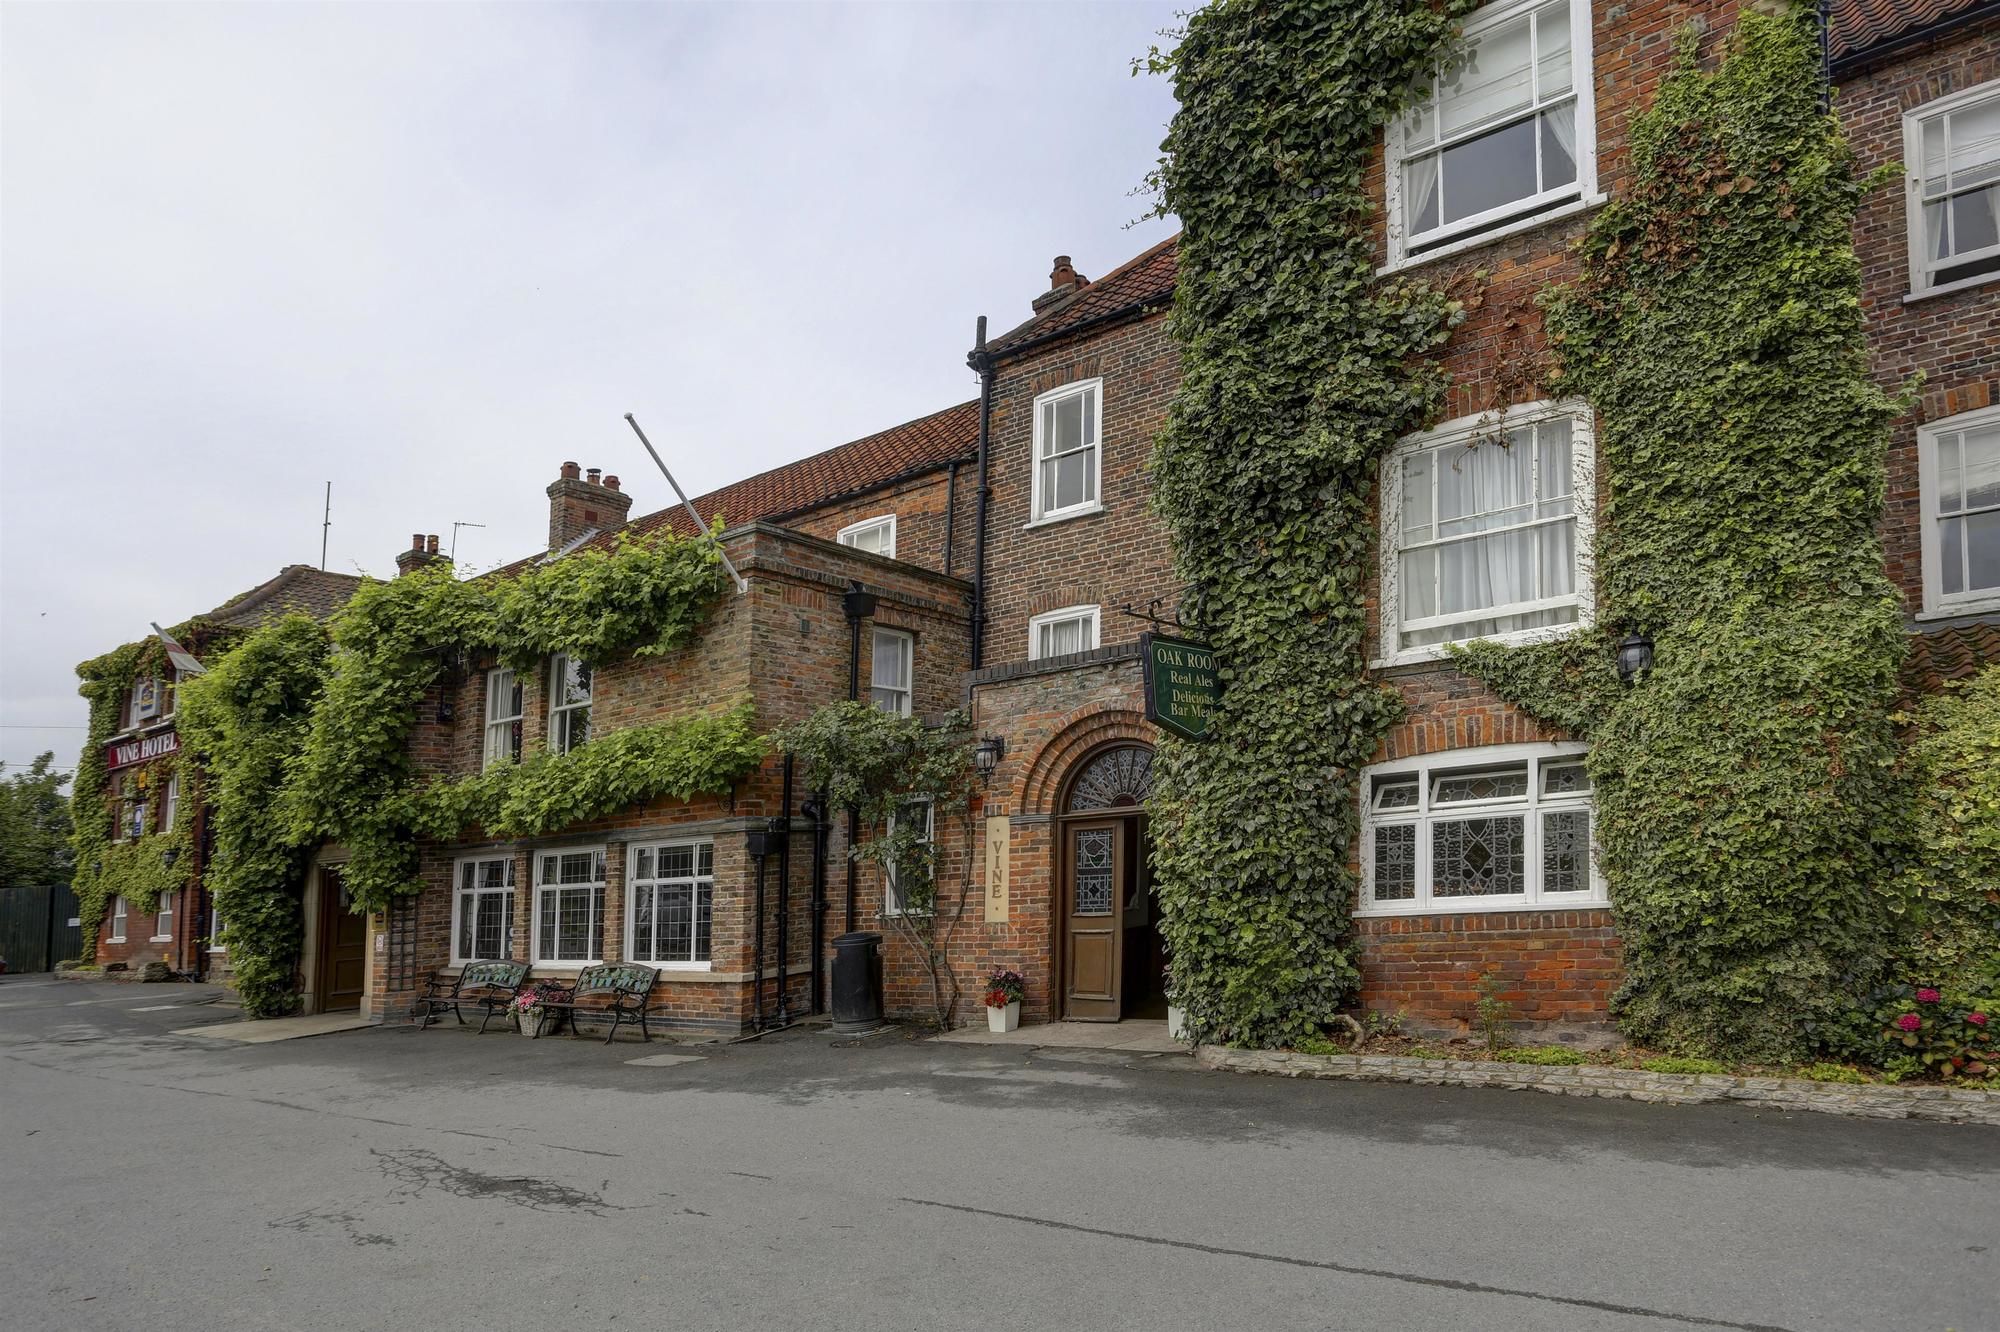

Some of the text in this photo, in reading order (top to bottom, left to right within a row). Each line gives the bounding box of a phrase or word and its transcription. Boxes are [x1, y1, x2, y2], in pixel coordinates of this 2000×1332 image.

[1157, 648, 1221, 671] OAK ROOM
[1170, 670, 1214, 688] Real Ales
[1171, 703, 1188, 716] Bar
[116, 732, 177, 764] VINE HOTEL
[991, 840, 1003, 899] VINE
